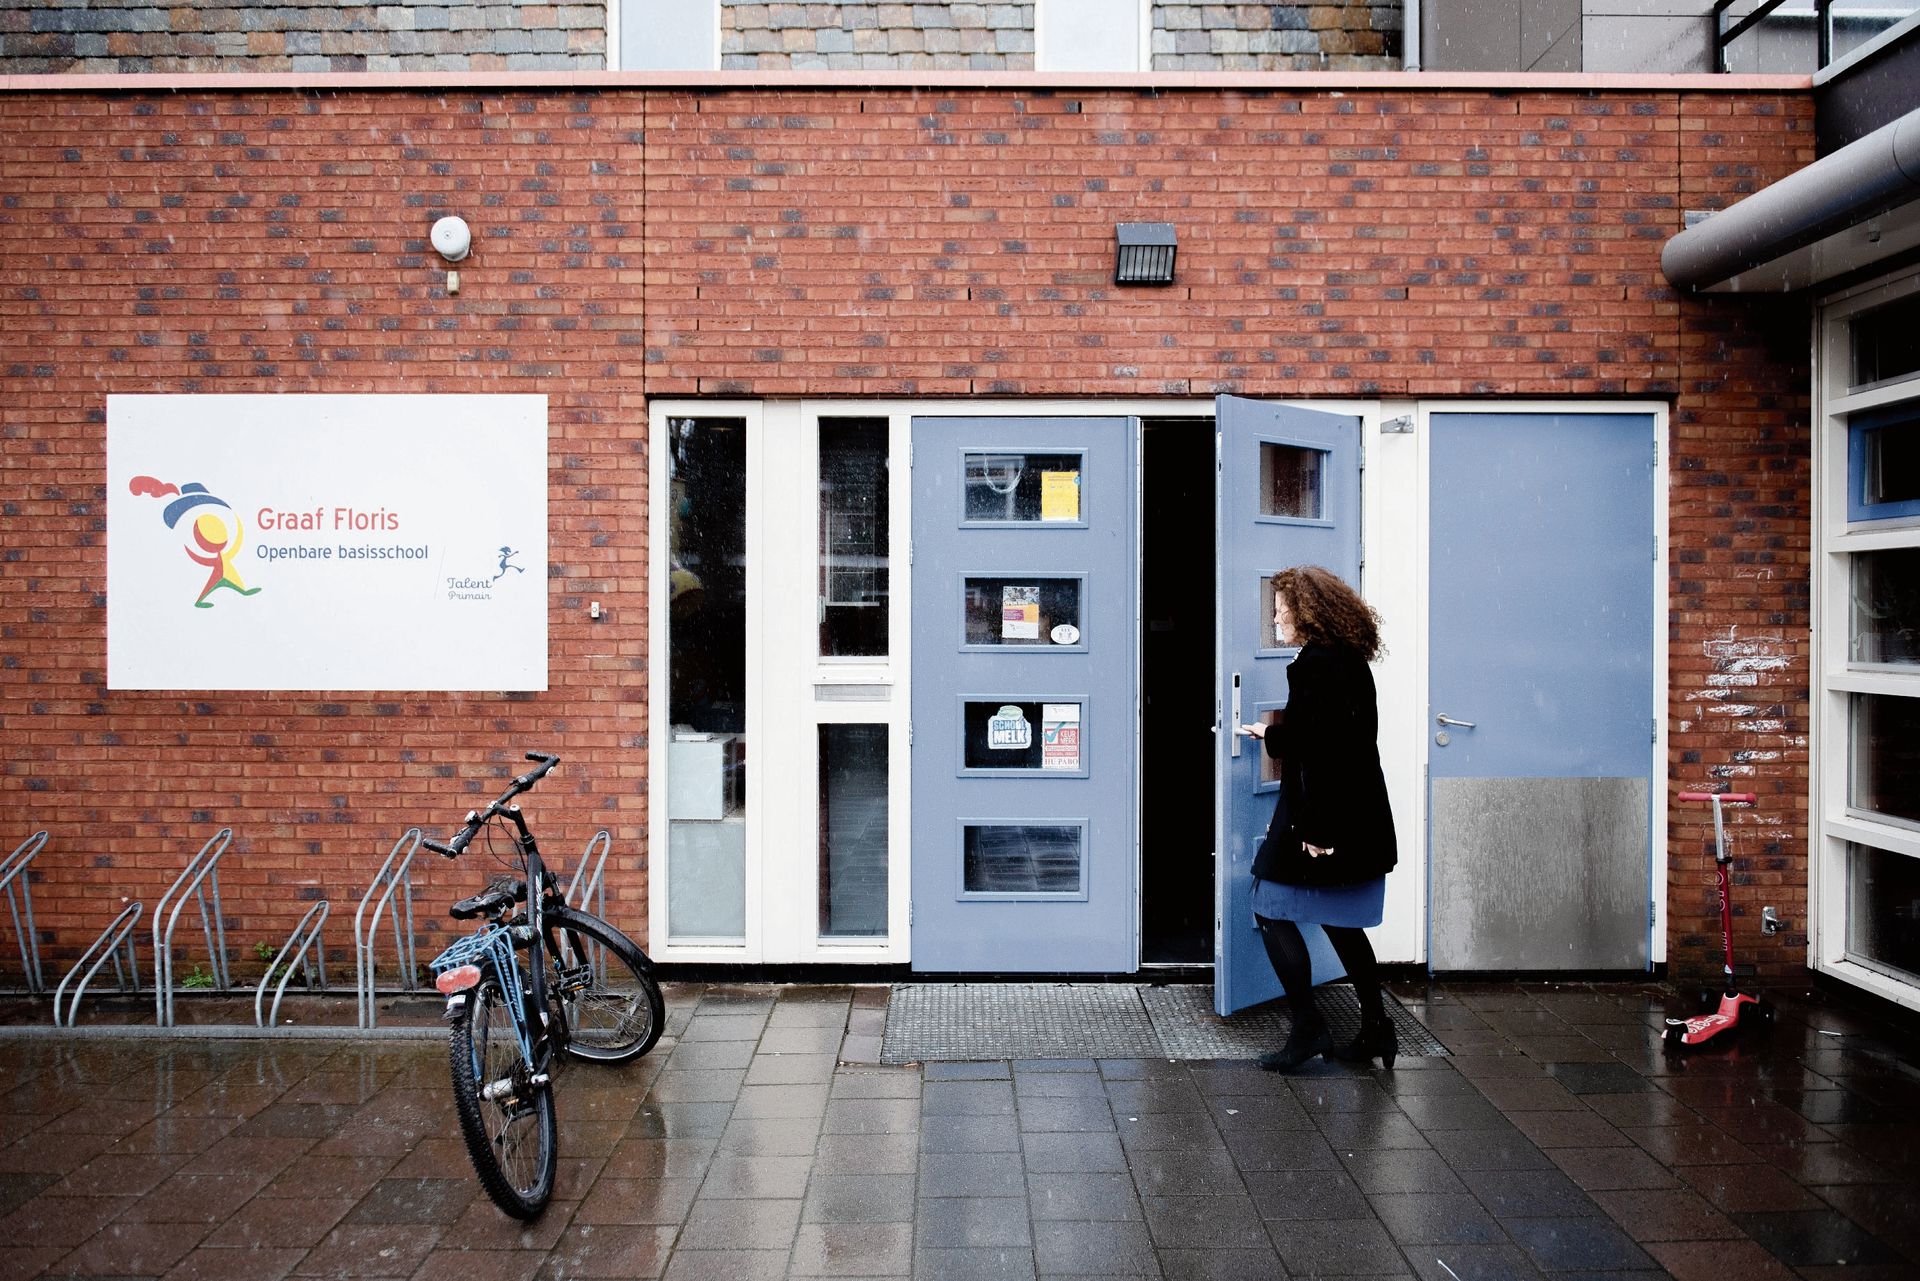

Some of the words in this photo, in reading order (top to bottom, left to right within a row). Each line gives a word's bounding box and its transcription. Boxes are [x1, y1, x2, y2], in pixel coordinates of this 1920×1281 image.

[257, 507, 324, 531] Graaf
[334, 507, 399, 531] Floris
[256, 545, 332, 562] Openbare
[338, 544, 429, 560] basisschool
[447, 577, 492, 589] Talent
[448, 590, 492, 600] Primair
[993, 730, 1027, 744] MELK
